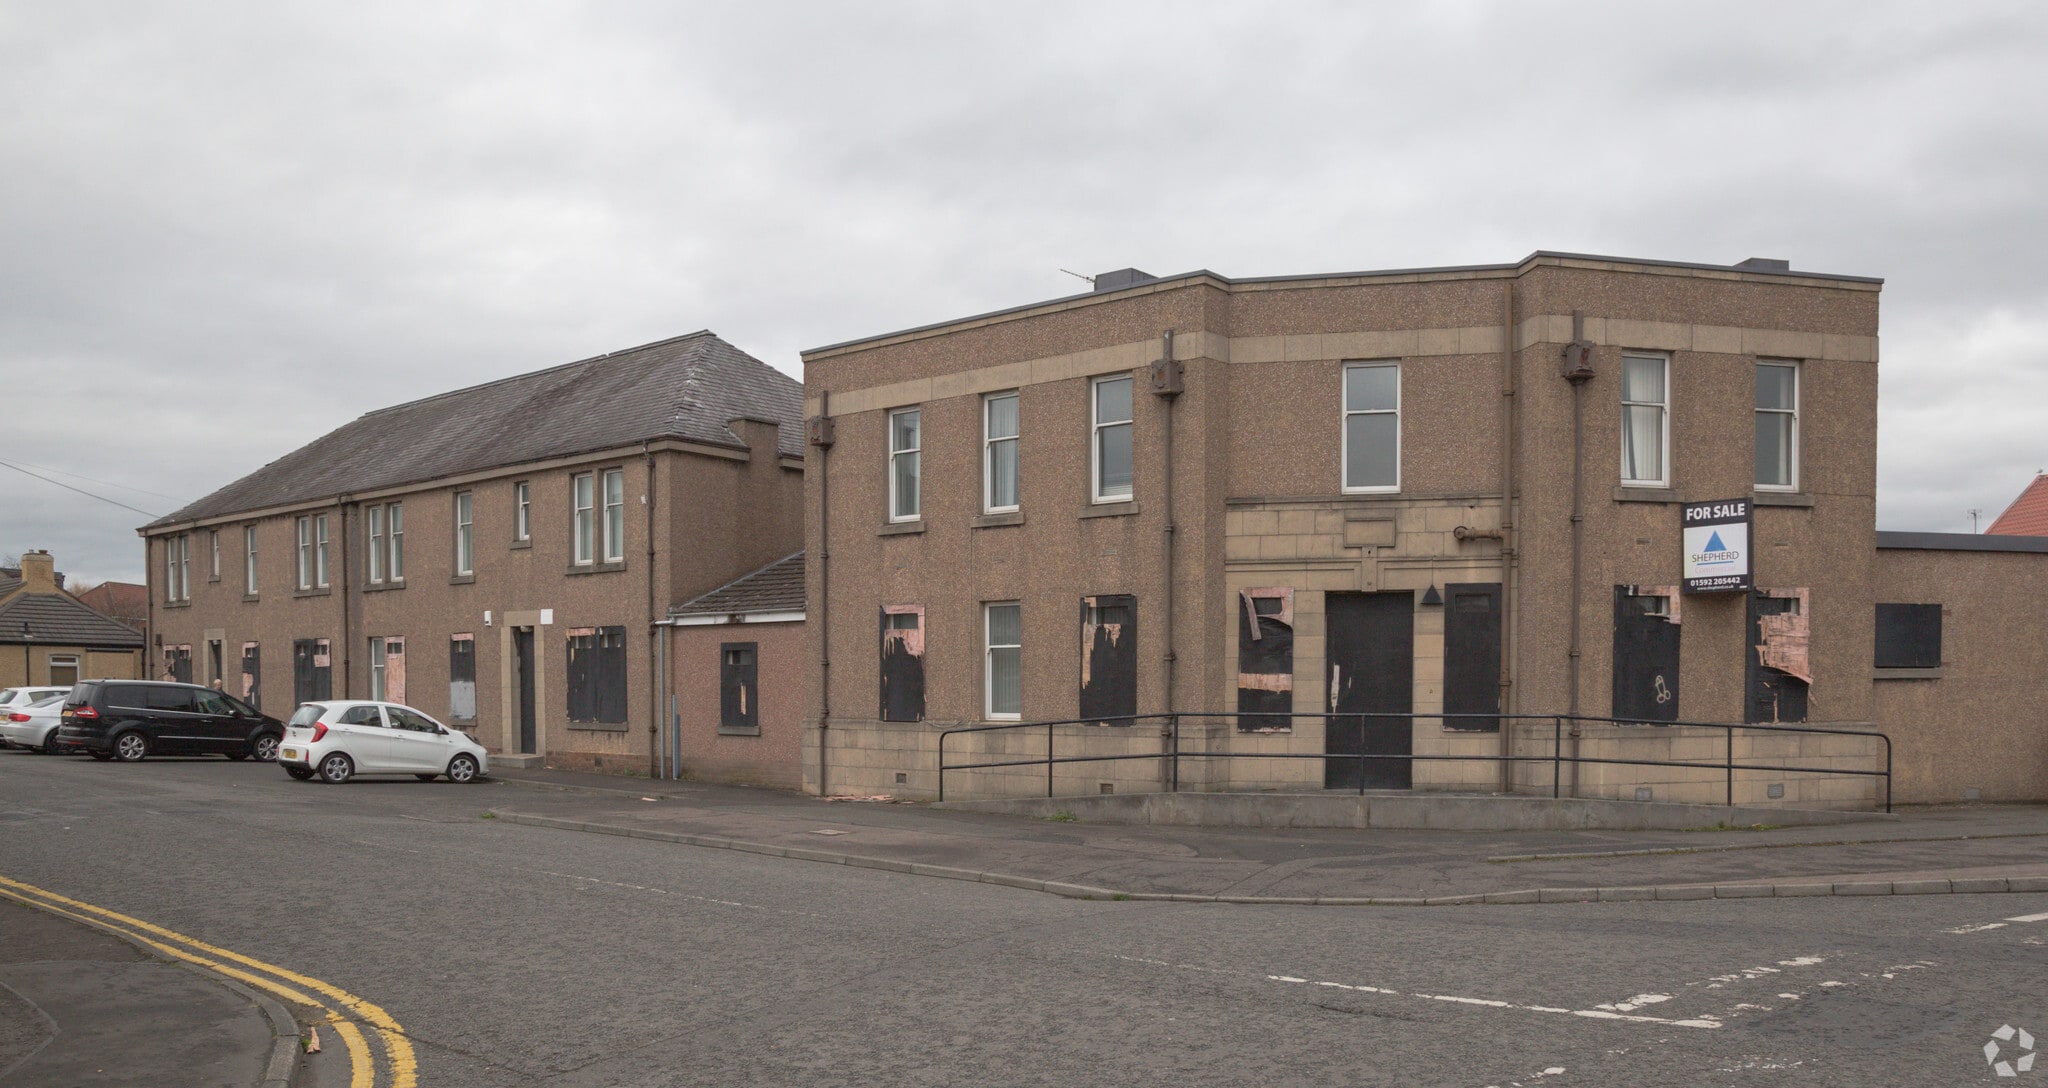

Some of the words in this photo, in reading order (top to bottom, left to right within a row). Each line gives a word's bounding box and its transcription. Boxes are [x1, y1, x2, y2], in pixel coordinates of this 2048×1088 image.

[1686, 506, 1711, 521] FOR
[1713, 503, 1745, 518] SALE
[1691, 551, 1740, 563] SHEPHERD
[1690, 578, 1713, 587] 01592
[1713, 576, 1741, 585] 205442
